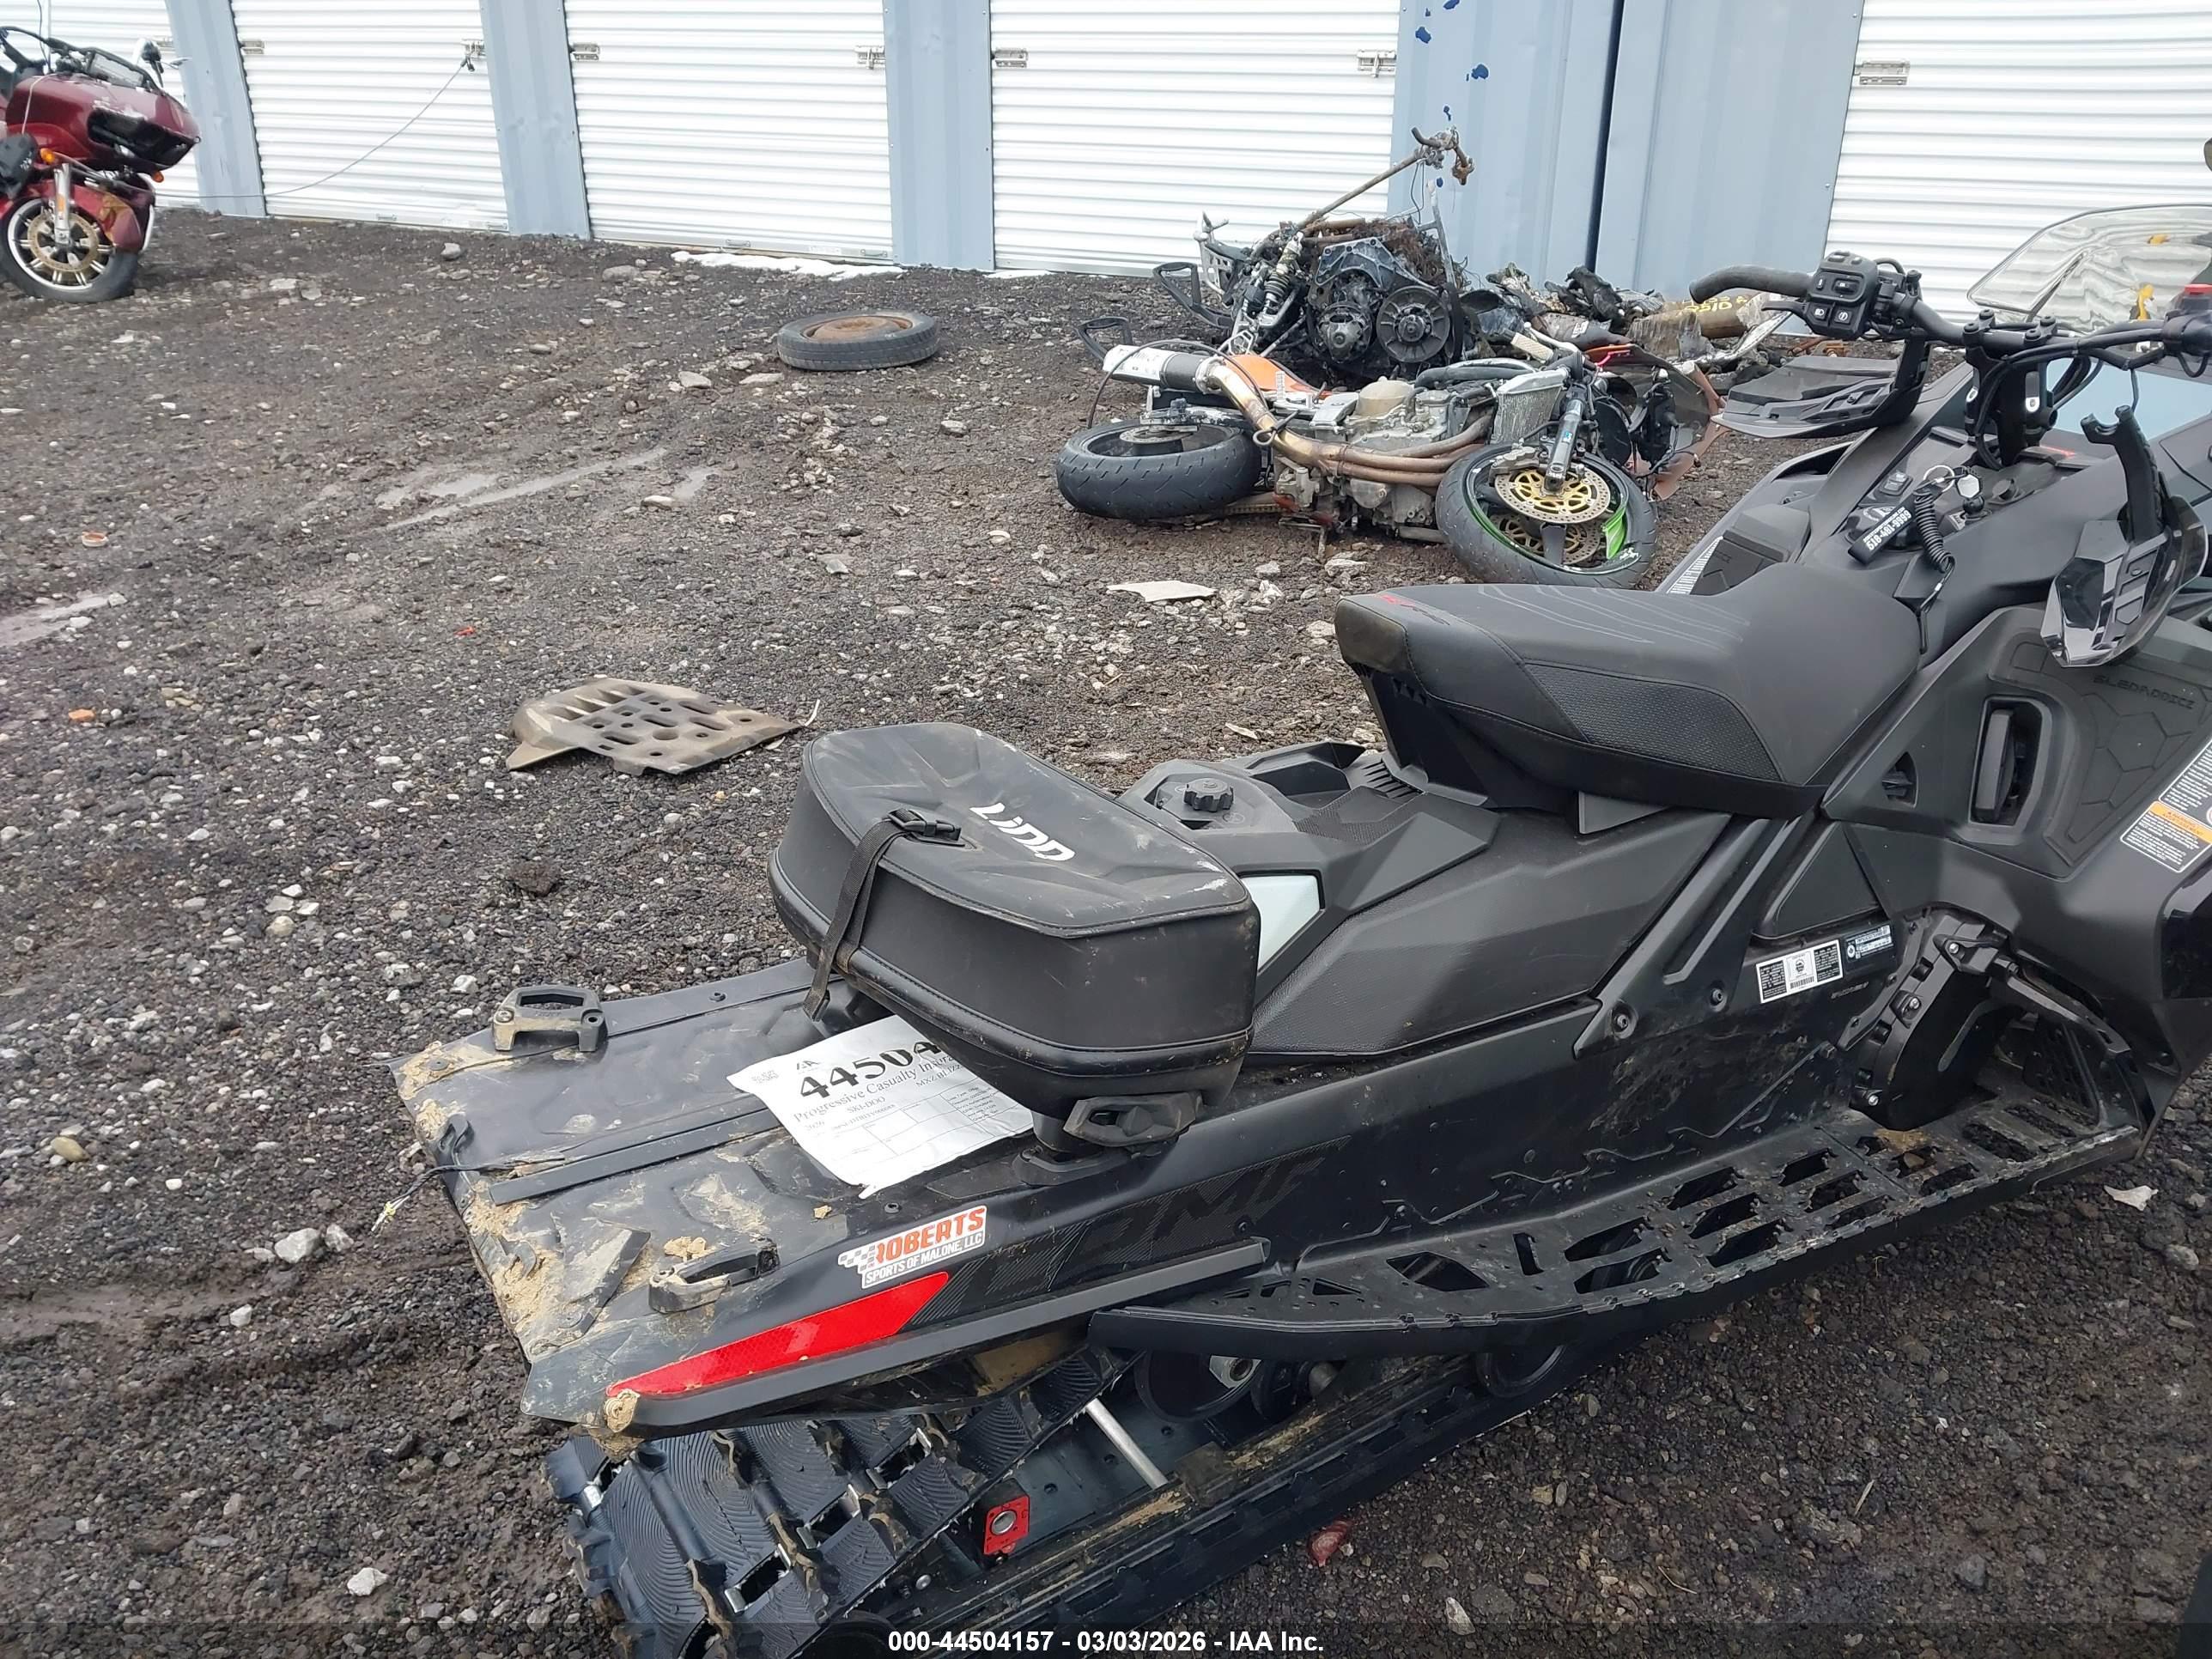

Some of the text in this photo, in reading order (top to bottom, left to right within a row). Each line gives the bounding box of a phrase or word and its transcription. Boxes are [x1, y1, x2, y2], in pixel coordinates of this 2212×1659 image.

[1866, 510, 1911, 550] 518-481-9999
[793, 1091, 866, 1122] Progressive
[866, 1068, 917, 1096] Casualty
[847, 1096, 885, 1113] SKI-DOO
[866, 1232, 983, 1285] SPORTS OF MALONE, LLC
[875, 1207, 986, 1264] ROBERTS
